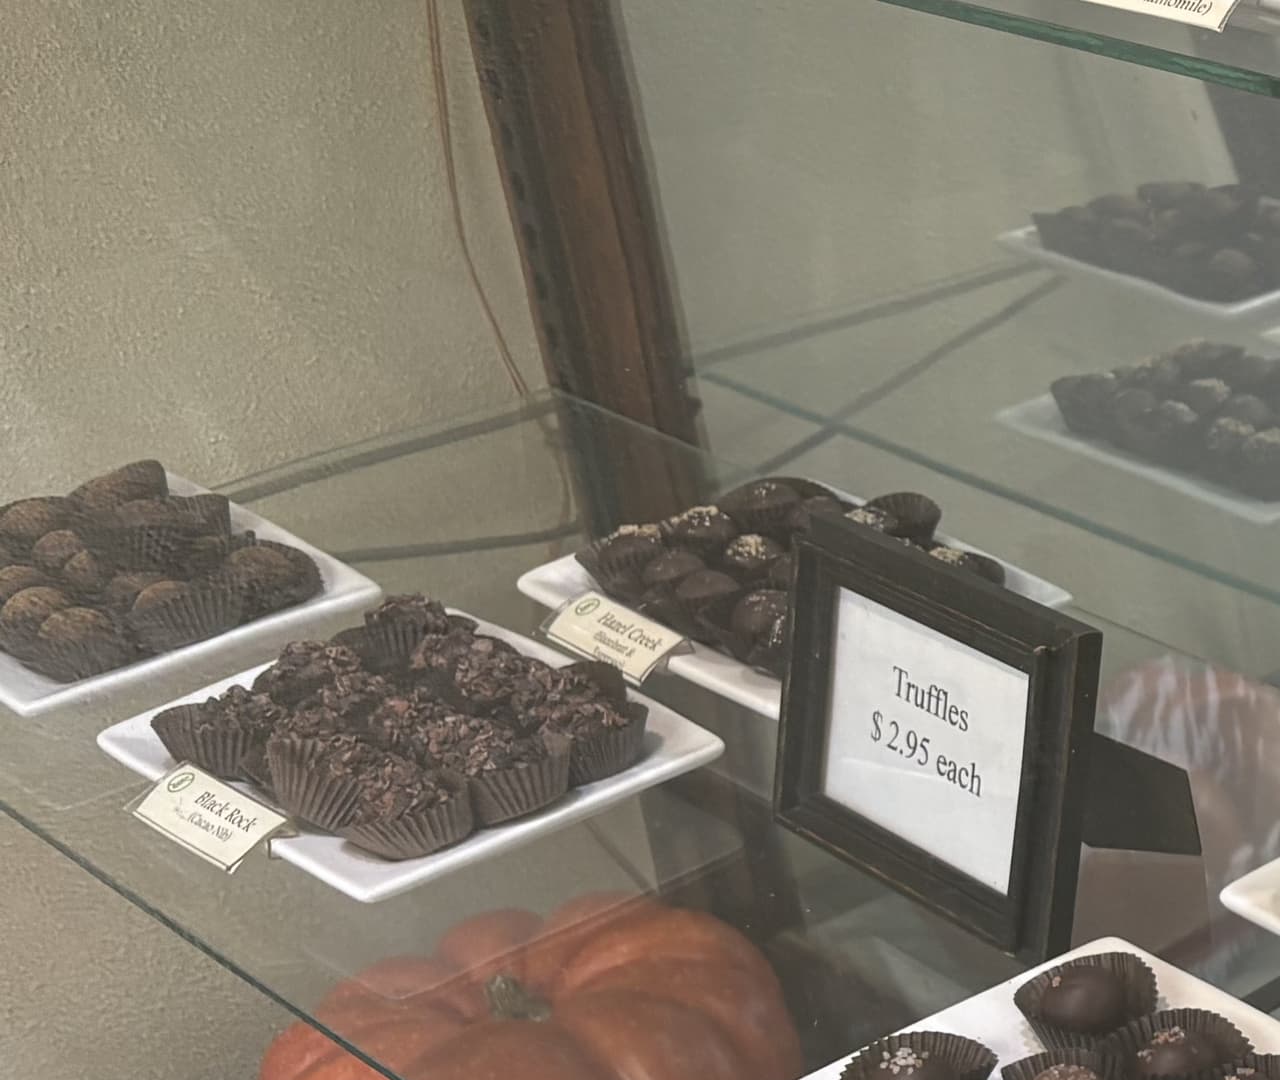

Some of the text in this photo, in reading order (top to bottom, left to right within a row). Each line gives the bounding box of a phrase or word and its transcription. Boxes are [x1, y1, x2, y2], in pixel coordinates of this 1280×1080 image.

[598, 611, 663, 652] Hazel Creek
[892, 665, 970, 733] Truffles
[886, 720, 930, 767] 2.95
[936, 754, 982, 798] each
[194, 791, 257, 833] Black Rock
